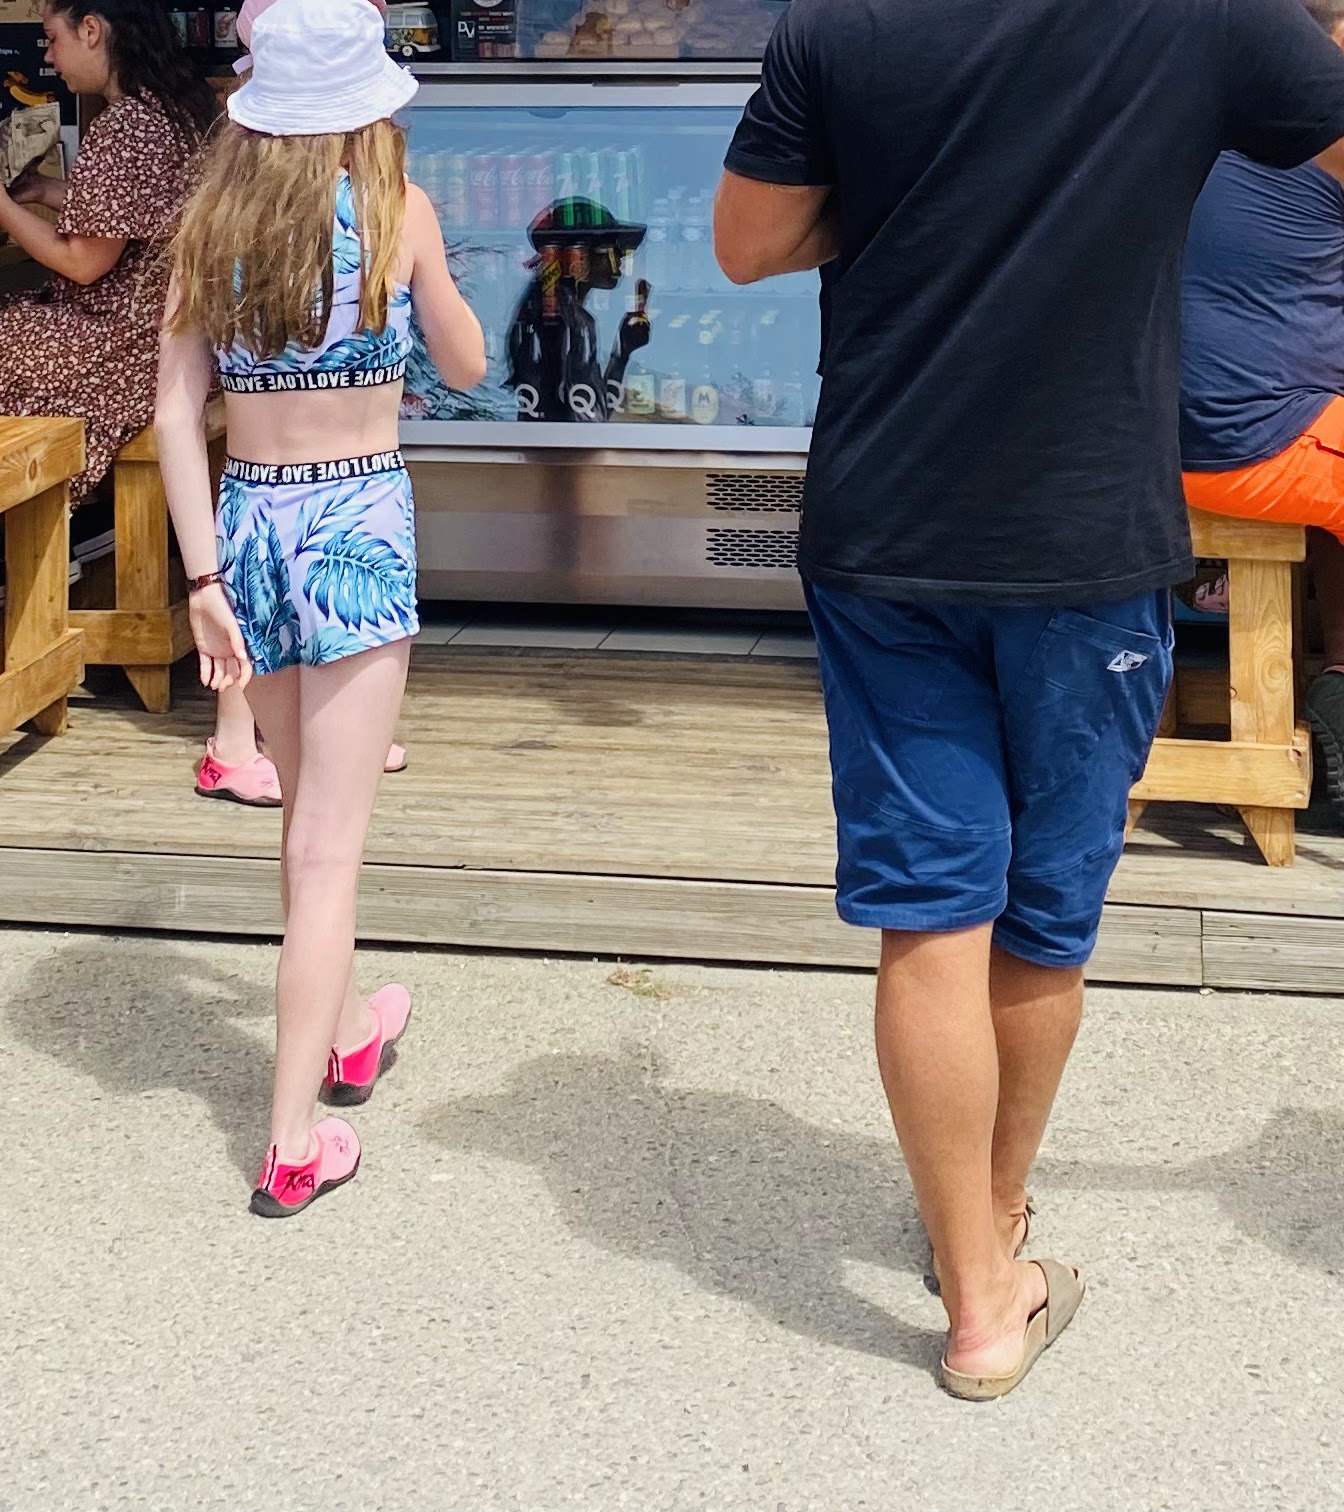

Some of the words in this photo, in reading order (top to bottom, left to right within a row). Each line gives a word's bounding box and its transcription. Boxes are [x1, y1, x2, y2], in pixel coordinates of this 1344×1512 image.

[308, 371, 349, 388] LOVE
[246, 463, 277, 482] LOVE
[280, 463, 312, 482] OVE
[362, 452, 398, 473] LOVE
